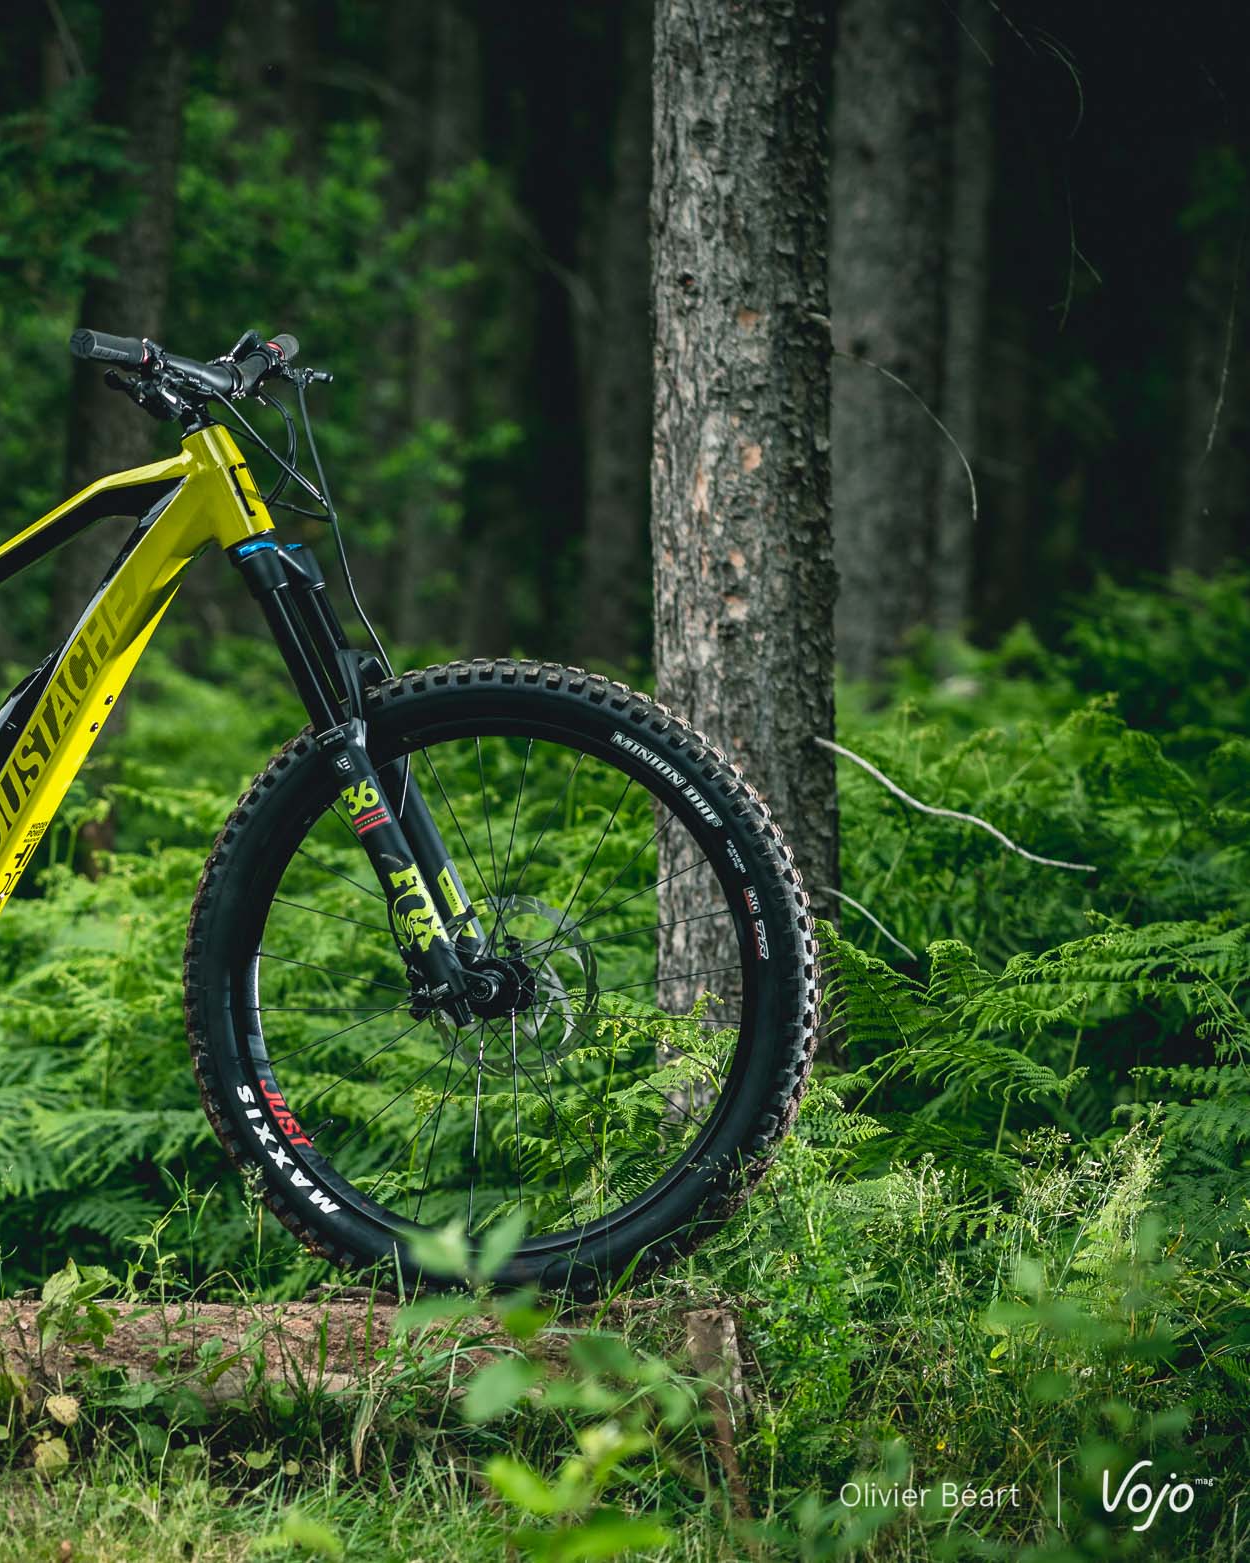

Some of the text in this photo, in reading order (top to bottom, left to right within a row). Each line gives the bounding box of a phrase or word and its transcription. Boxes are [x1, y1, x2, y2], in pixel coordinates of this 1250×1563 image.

[610, 732, 686, 788] MINION
[342, 780, 379, 816] 36
[390, 863, 450, 953] FOX
[746, 887, 761, 914] EXO
[755, 919, 770, 960] TR
[260, 1080, 313, 1148] JUST
[236, 1085, 341, 1214] MAXXIS
